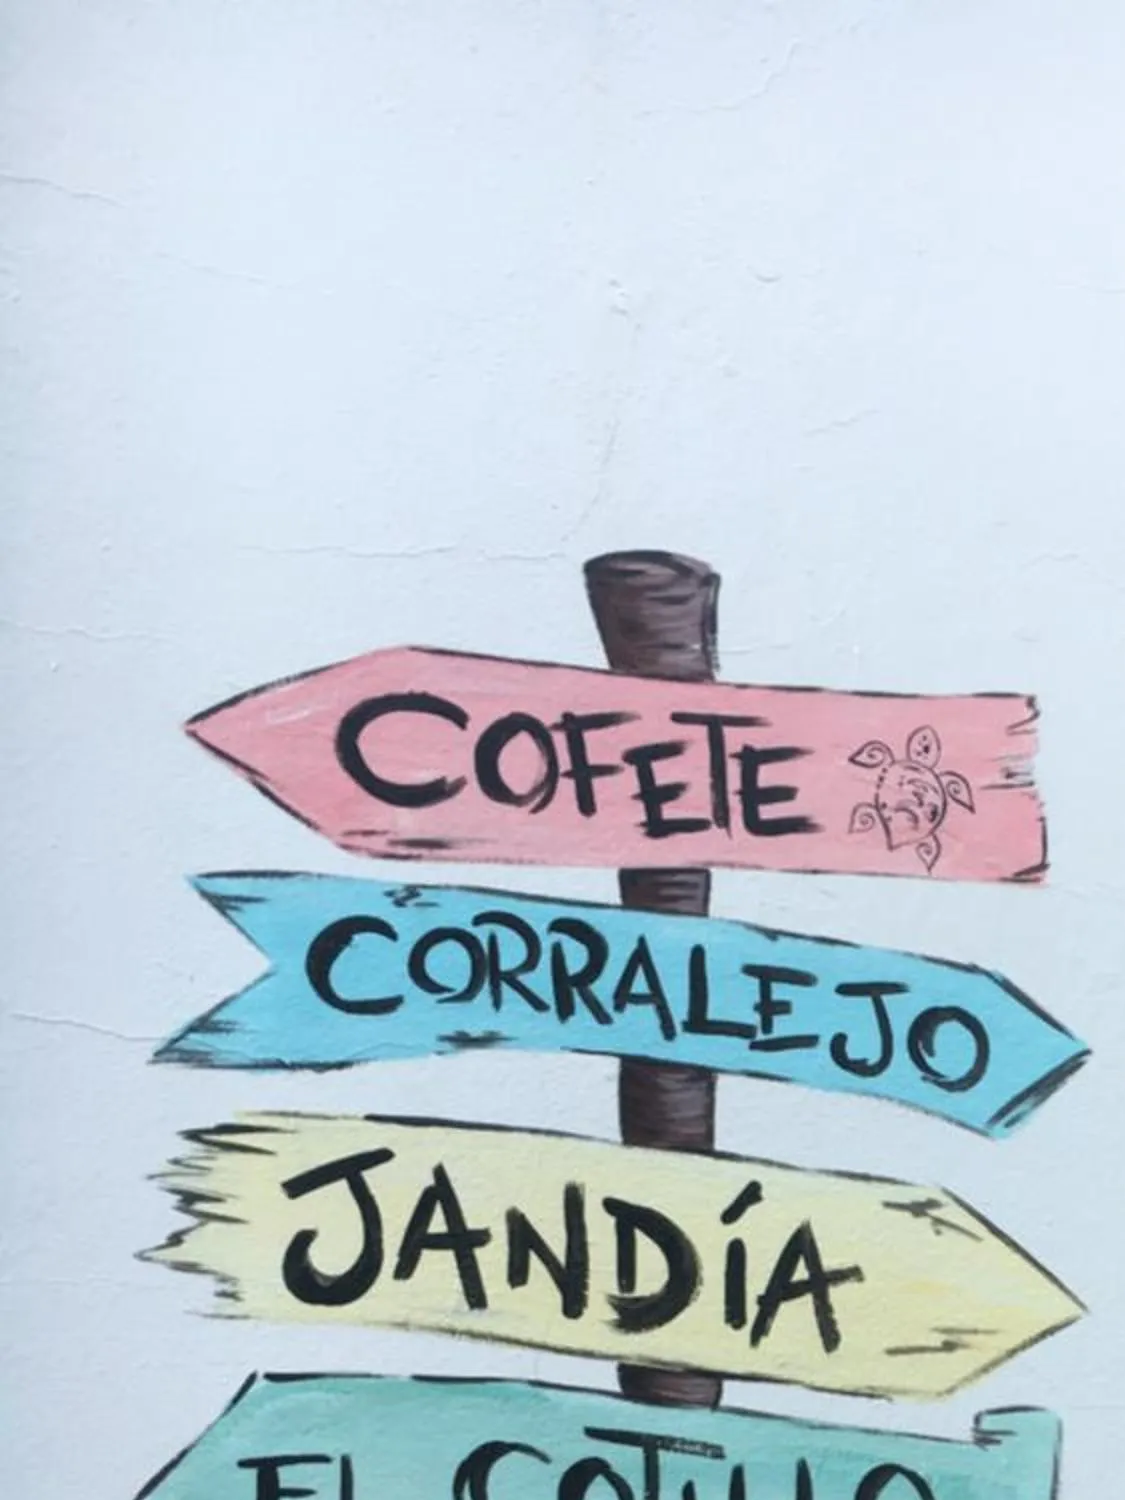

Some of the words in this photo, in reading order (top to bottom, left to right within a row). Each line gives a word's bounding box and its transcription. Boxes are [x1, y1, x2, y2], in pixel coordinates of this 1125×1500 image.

[335, 693, 826, 837] COFETE
[304, 911, 990, 1092] CORRALEJO
[280, 1148, 863, 1352] JANDÍA
